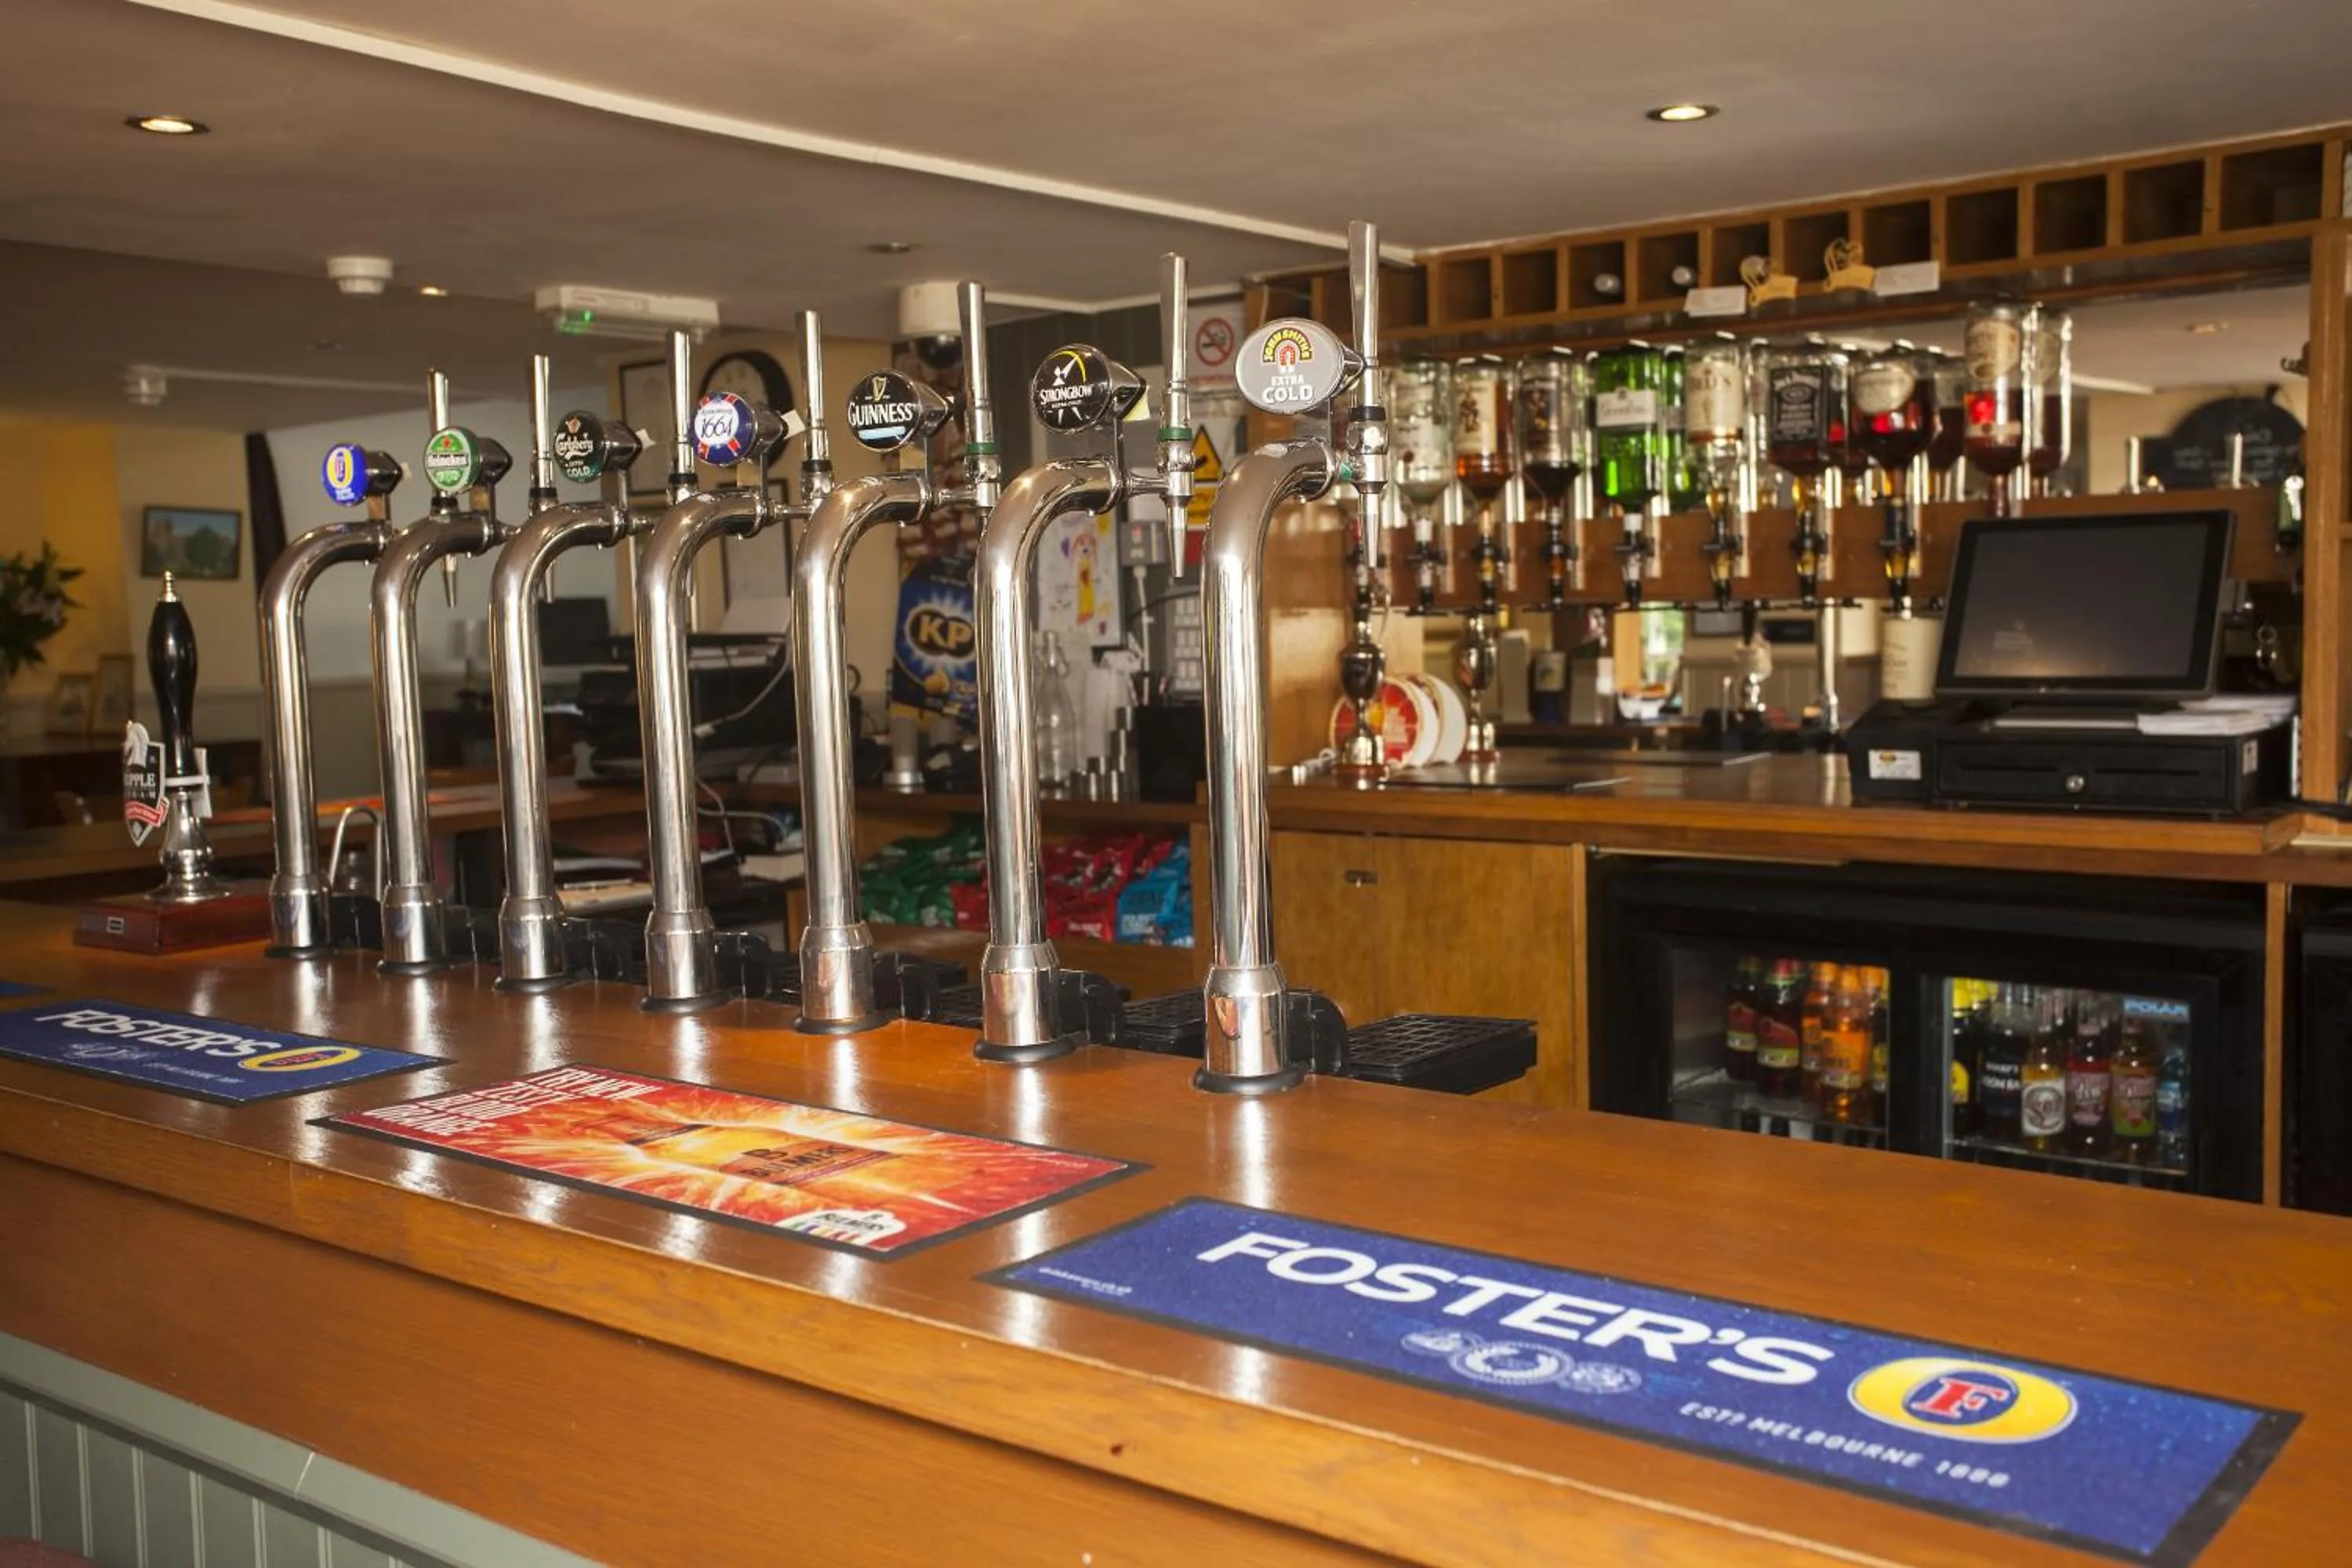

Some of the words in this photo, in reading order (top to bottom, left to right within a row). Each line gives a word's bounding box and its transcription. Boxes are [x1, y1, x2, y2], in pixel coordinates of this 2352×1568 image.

[1271, 374, 1305, 387] EXTRA
[1040, 384, 1094, 405] STRONGBOW
[1262, 384, 1315, 405] COLD
[700, 416, 734, 438] 1664
[848, 401, 913, 427] GUINNESS
[554, 431, 594, 456] Carlsberg
[566, 466, 592, 478] COLD
[919, 615, 972, 650] KP
[34, 1009, 282, 1057] FOSTER'S
[527, 1068, 605, 1091] TRY
[417, 1094, 533, 1120] BLOOD
[472, 1081, 585, 1108] ZESTY
[362, 1105, 498, 1135] ORANGE
[1196, 1232, 1835, 1385] FOSTER'S
[1911, 1377, 2010, 1417] F
[1748, 1417, 1924, 1468] MELBOURNE
